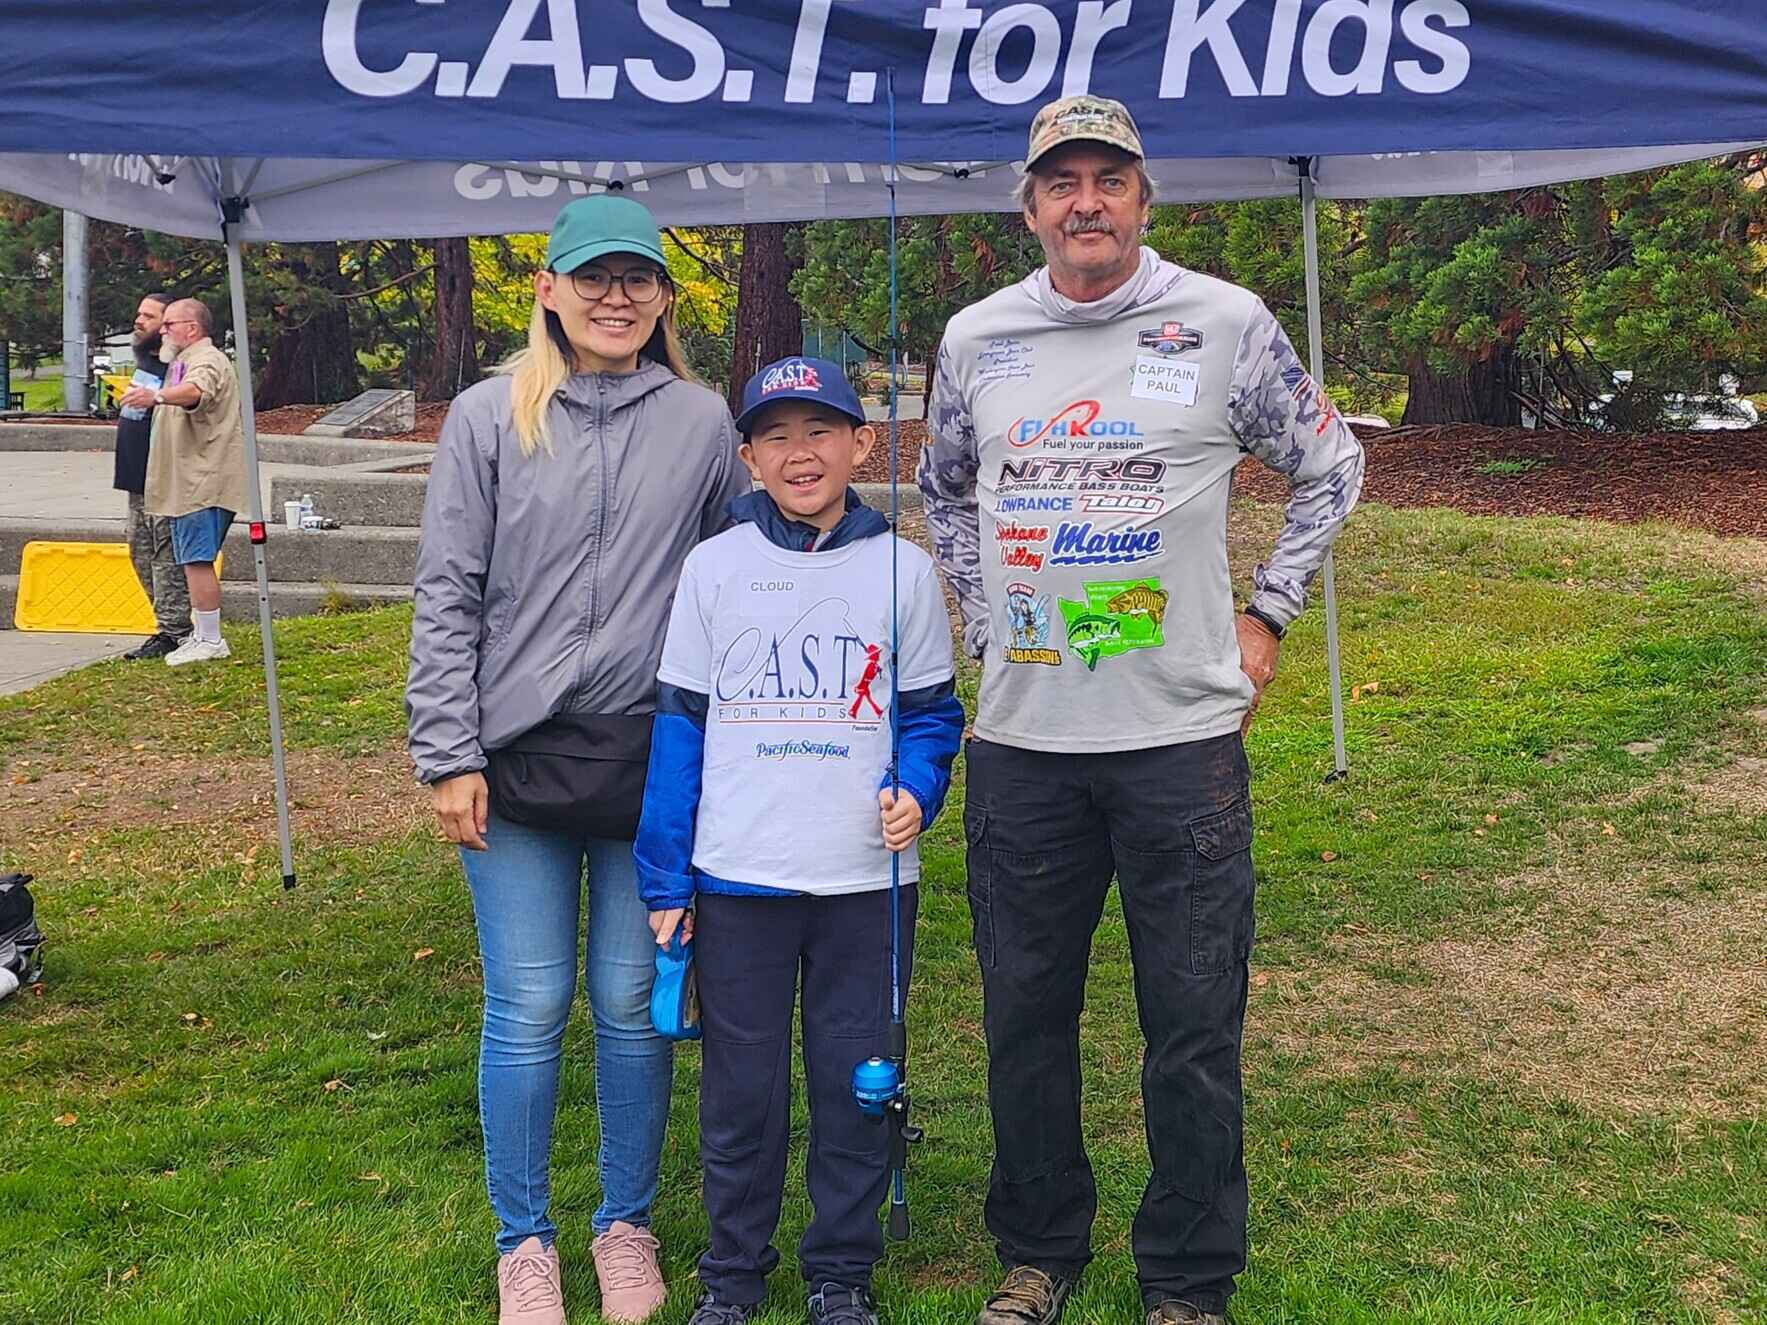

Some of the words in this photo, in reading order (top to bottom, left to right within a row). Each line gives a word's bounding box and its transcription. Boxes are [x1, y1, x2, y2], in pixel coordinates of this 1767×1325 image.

[921, 0, 1130, 106] for
[1138, 364, 1196, 381] CAPTAIN
[1146, 380, 1182, 394] PAUL
[1042, 439, 1067, 449] Fuel
[1069, 440, 1095, 451] your
[1097, 439, 1144, 451] passion
[994, 482, 1075, 495] PERFORMANCE
[1078, 482, 1117, 491] BASS
[1119, 483, 1166, 494] BOATS
[994, 497, 1073, 513] LOWRANCE
[1052, 522, 1162, 556] Marine
[1001, 545, 1045, 572] Valley
[750, 581, 794, 592] CLOUD
[718, 707, 759, 719] FOR
[779, 707, 849, 719] KIDS
